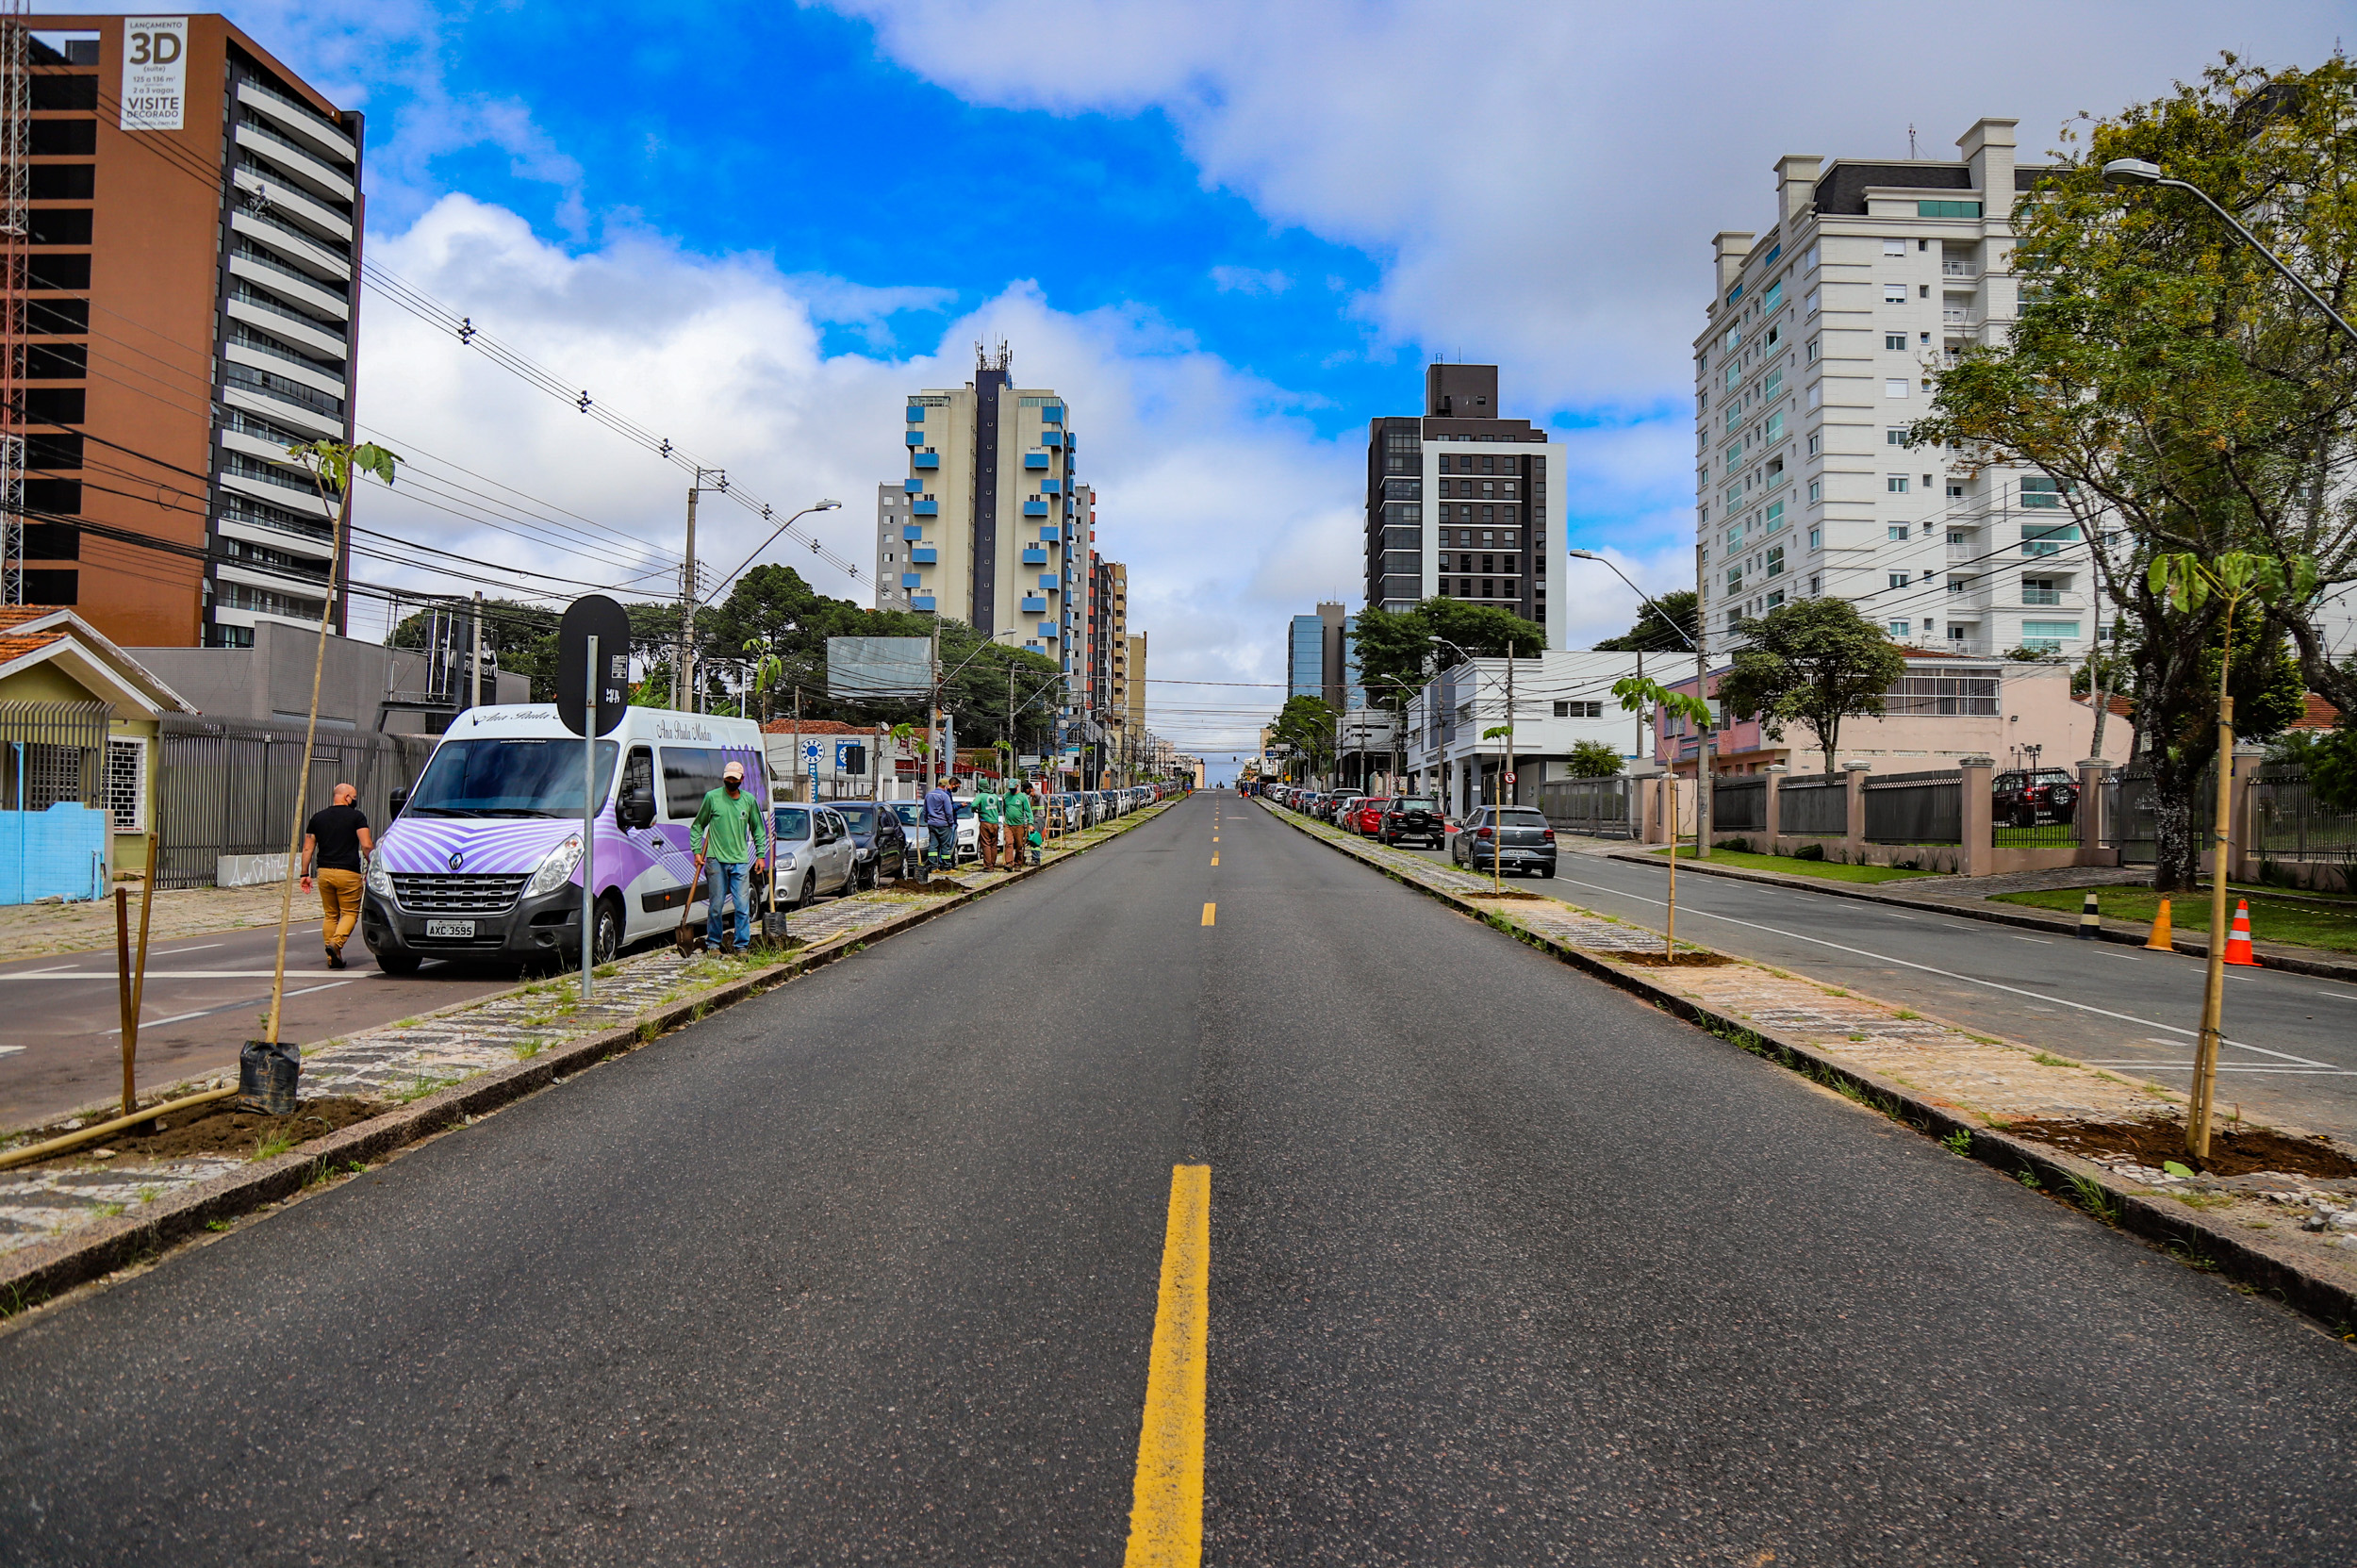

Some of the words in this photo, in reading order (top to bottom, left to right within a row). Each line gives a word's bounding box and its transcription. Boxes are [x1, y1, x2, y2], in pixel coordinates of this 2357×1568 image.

[129, 32, 181, 65] 3D
[128, 97, 179, 109] VISITE
[476, 713, 508, 723] Ana
[510, 711, 550, 720] Paula
[656, 719, 673, 739] Ana
[674, 720, 691, 740] Paula
[692, 723, 712, 741] Modas
